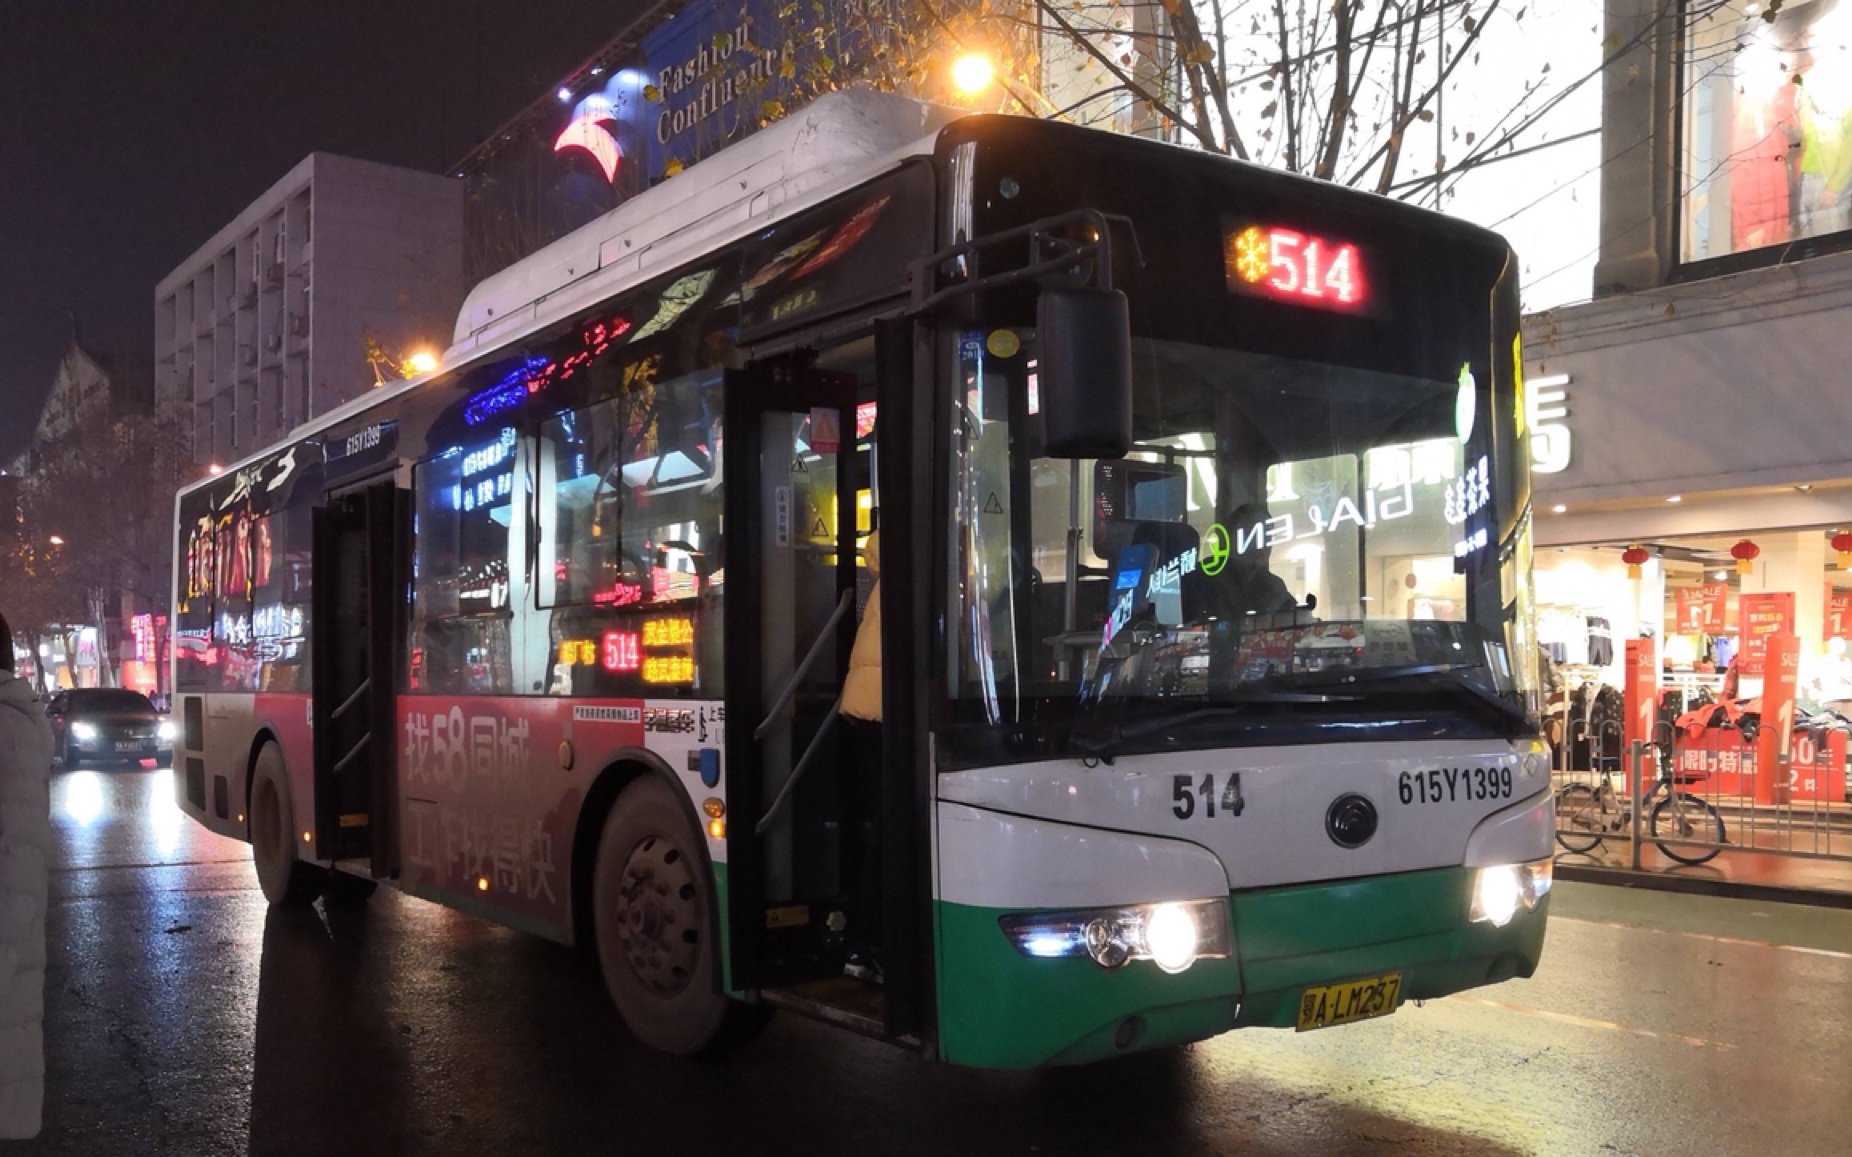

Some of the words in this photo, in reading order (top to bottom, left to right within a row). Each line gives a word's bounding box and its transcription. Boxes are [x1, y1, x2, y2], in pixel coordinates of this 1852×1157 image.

[657, 21, 749, 103] Fashion
[1269, 232, 1353, 303] 514
[606, 633, 640, 669] 514
[404, 705, 530, 788] 找58同城
[1172, 772, 1245, 820] 514
[1399, 766, 1513, 806] 615Y1399
